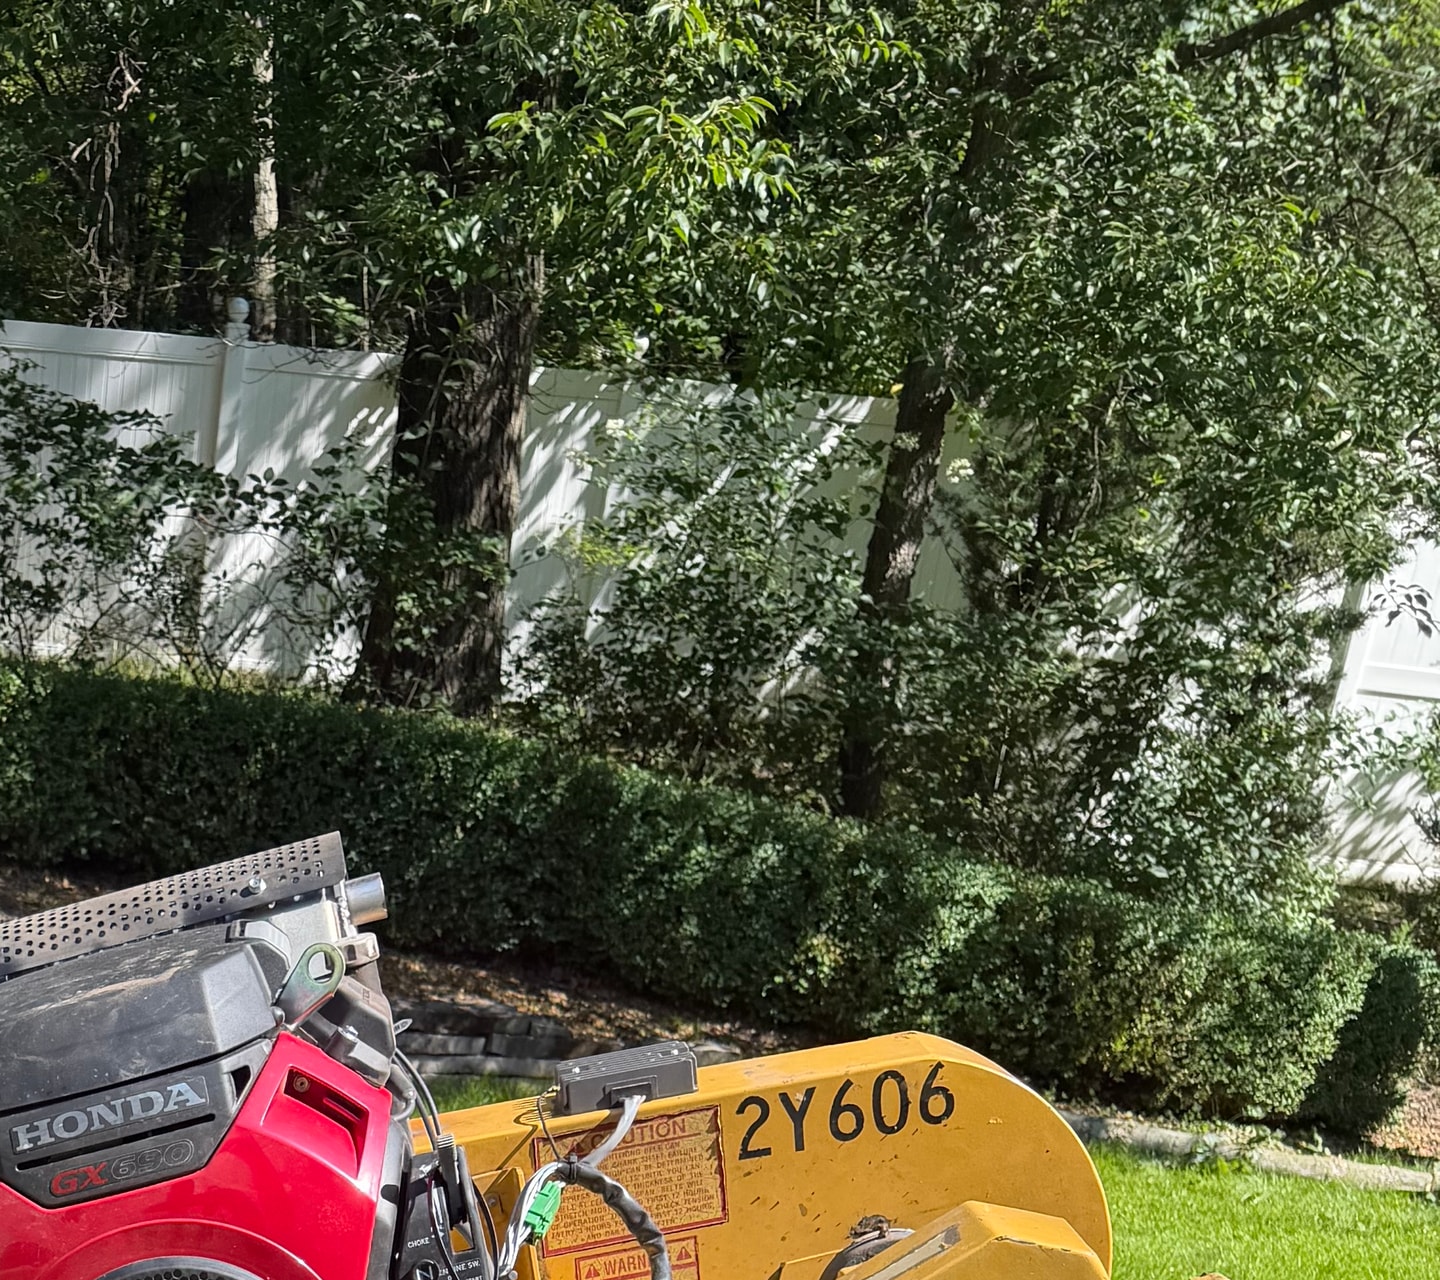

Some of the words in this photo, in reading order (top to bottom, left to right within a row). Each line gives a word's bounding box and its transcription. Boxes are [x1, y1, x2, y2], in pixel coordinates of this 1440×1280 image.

[12, 1082, 207, 1152] HONDA
[735, 1060, 955, 1161] 2Y606
[591, 1117, 686, 1152] CUTION
[407, 1237, 431, 1249] CHOKE
[439, 1263, 467, 1277] ENINE
[603, 1254, 648, 1277] WARN
